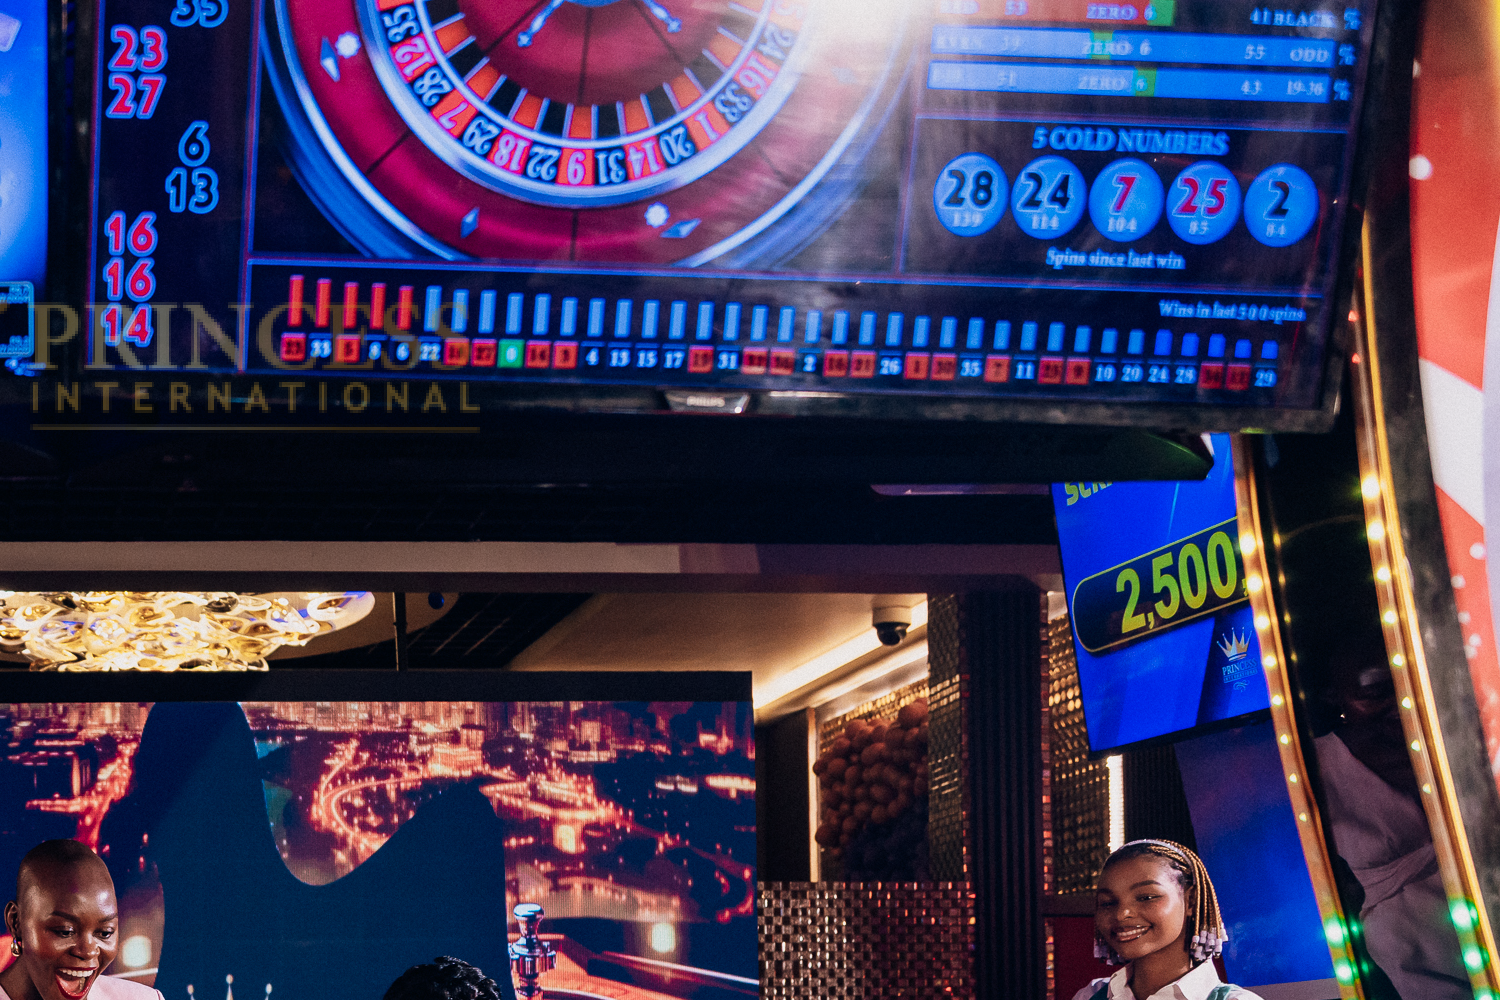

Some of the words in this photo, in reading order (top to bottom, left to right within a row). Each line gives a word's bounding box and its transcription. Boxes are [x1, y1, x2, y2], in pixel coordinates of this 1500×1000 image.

[1086, 3, 1138, 20] ZERO
[1273, 9, 1337, 28] BLACK
[108, 24, 168, 73] 23
[394, 35, 436, 77] 12
[1081, 41, 1129, 56] ZERO
[1140, 39, 1151, 55] 6
[1290, 48, 1329, 62] ODD
[413, 67, 452, 107] 28
[738, 52, 776, 94] 16
[1078, 76, 1126, 91] ZERO
[105, 72, 167, 119] 27
[439, 101, 469, 129] 7
[714, 82, 753, 122] 33
[178, 120, 210, 167] 6
[462, 118, 500, 155] 29
[658, 126, 695, 164] 20
[695, 112, 720, 141] 1
[1032, 126, 1049, 149] 5
[1049, 127, 1116, 152] COLD
[1117, 130, 1230, 156] NUMBERS
[493, 132, 529, 168] 18
[526, 147, 559, 181] 22
[566, 151, 586, 185] 9
[597, 149, 625, 183] 31
[627, 139, 662, 178] 14
[165, 167, 219, 214] 13
[941, 168, 994, 209] 28
[1017, 171, 1071, 212] 24
[1111, 174, 1139, 216] 7
[1172, 177, 1230, 218] 25
[1264, 180, 1291, 220] 2
[104, 210, 158, 257] 16
[1045, 246, 1088, 269] Spins
[1088, 251, 1128, 267] since
[1127, 250, 1155, 267] last
[1155, 253, 1186, 270] win
[102, 257, 156, 302] 16
[100, 303, 153, 348] 14
[1159, 300, 1196, 319] Wins
[1196, 302, 1213, 319] in
[1212, 302, 1237, 320] last
[1268, 306, 1306, 324] spins
[310, 339, 332, 358] 33
[396, 342, 409, 361] 6
[419, 342, 441, 361] 22
[506, 344, 518, 363] 0
[585, 348, 599, 366] 4
[609, 349, 630, 367] 13
[637, 350, 658, 368] 15
[663, 350, 685, 368] 17
[717, 351, 739, 370] 31
[803, 354, 817, 372] 2
[879, 357, 902, 375] 26
[960, 359, 983, 377] 35
[1015, 361, 1035, 379] 11
[1095, 364, 1117, 382] 10
[1148, 365, 1170, 383] 24
[1222, 658, 1257, 676] PRINCESS
